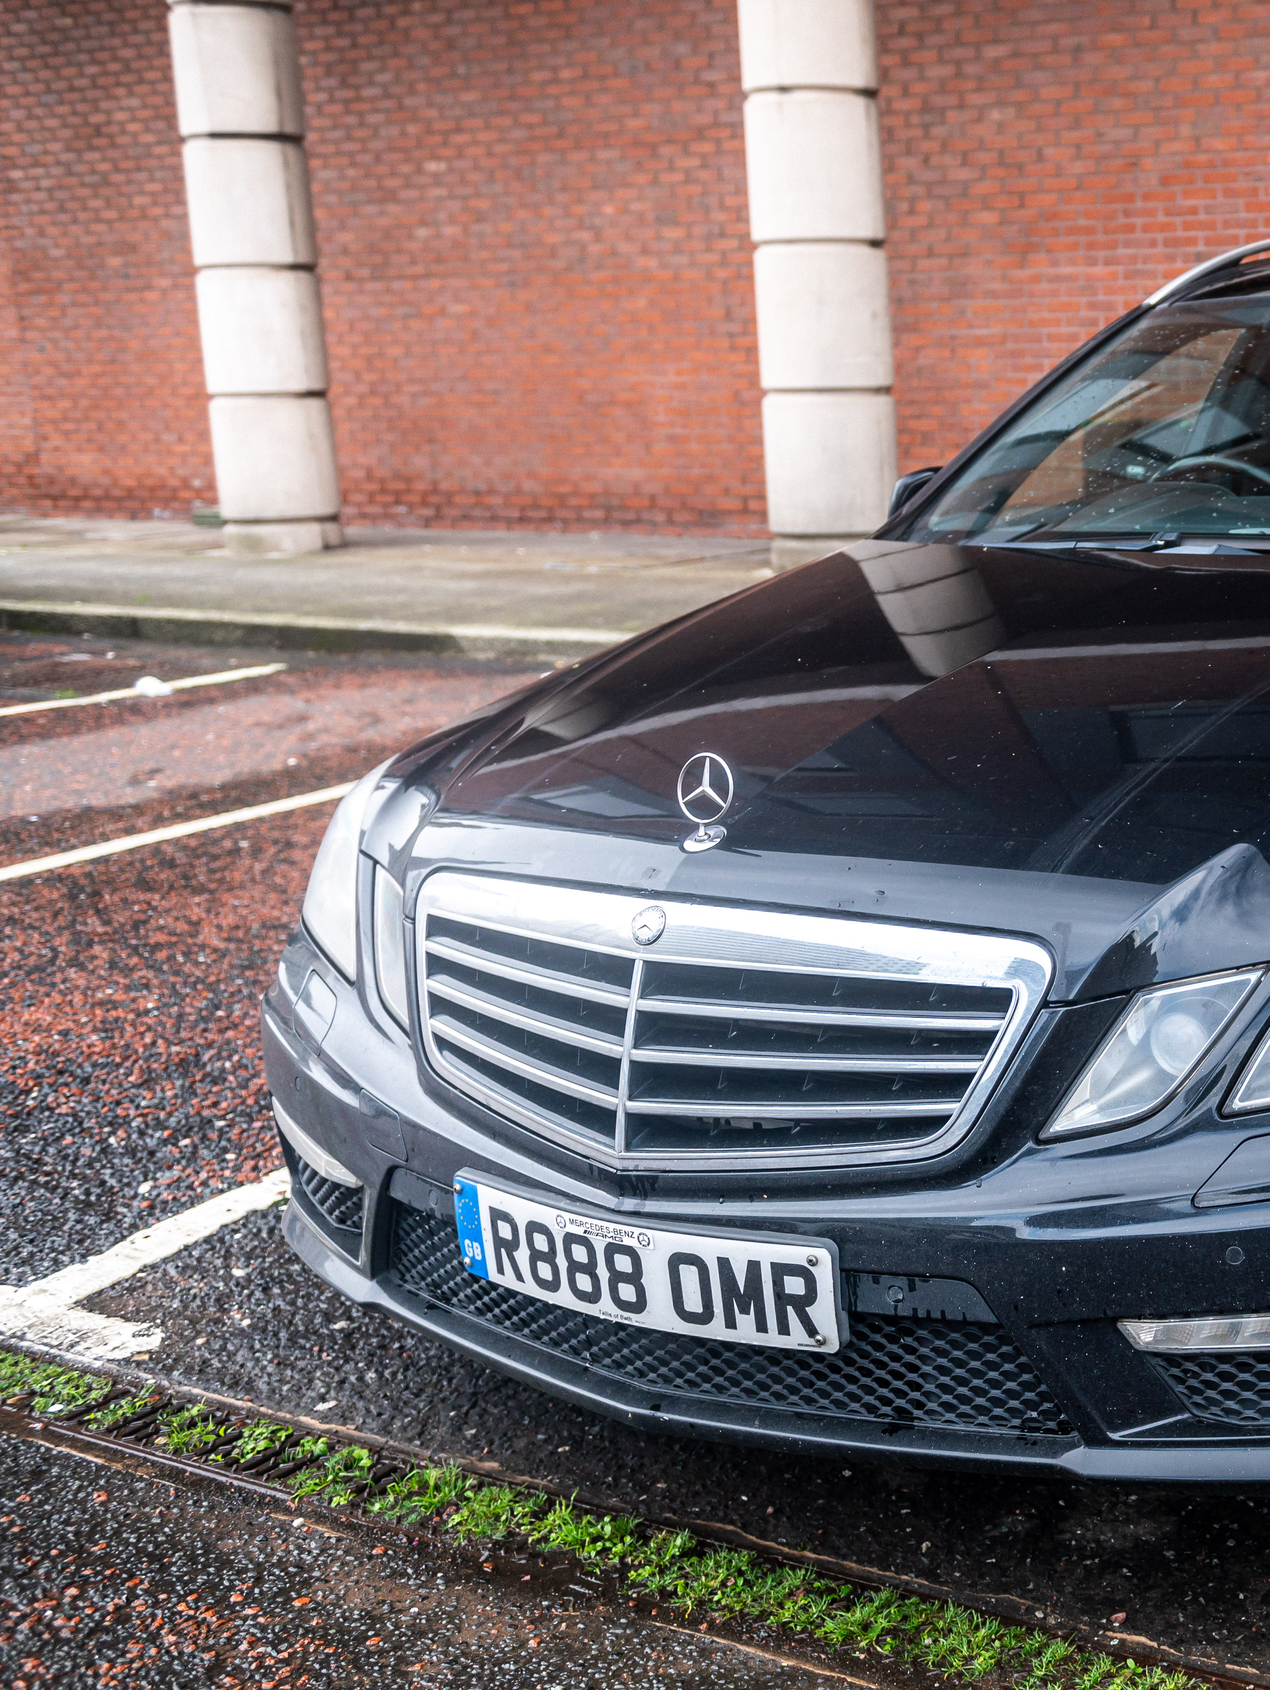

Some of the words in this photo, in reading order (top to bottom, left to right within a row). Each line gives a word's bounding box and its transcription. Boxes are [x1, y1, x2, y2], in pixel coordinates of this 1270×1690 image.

[568, 1217, 636, 1239] MERCEDES-BENZ
[464, 1238, 482, 1261] GB
[488, 1206, 648, 1314] R888
[667, 1251, 820, 1339] OMR
